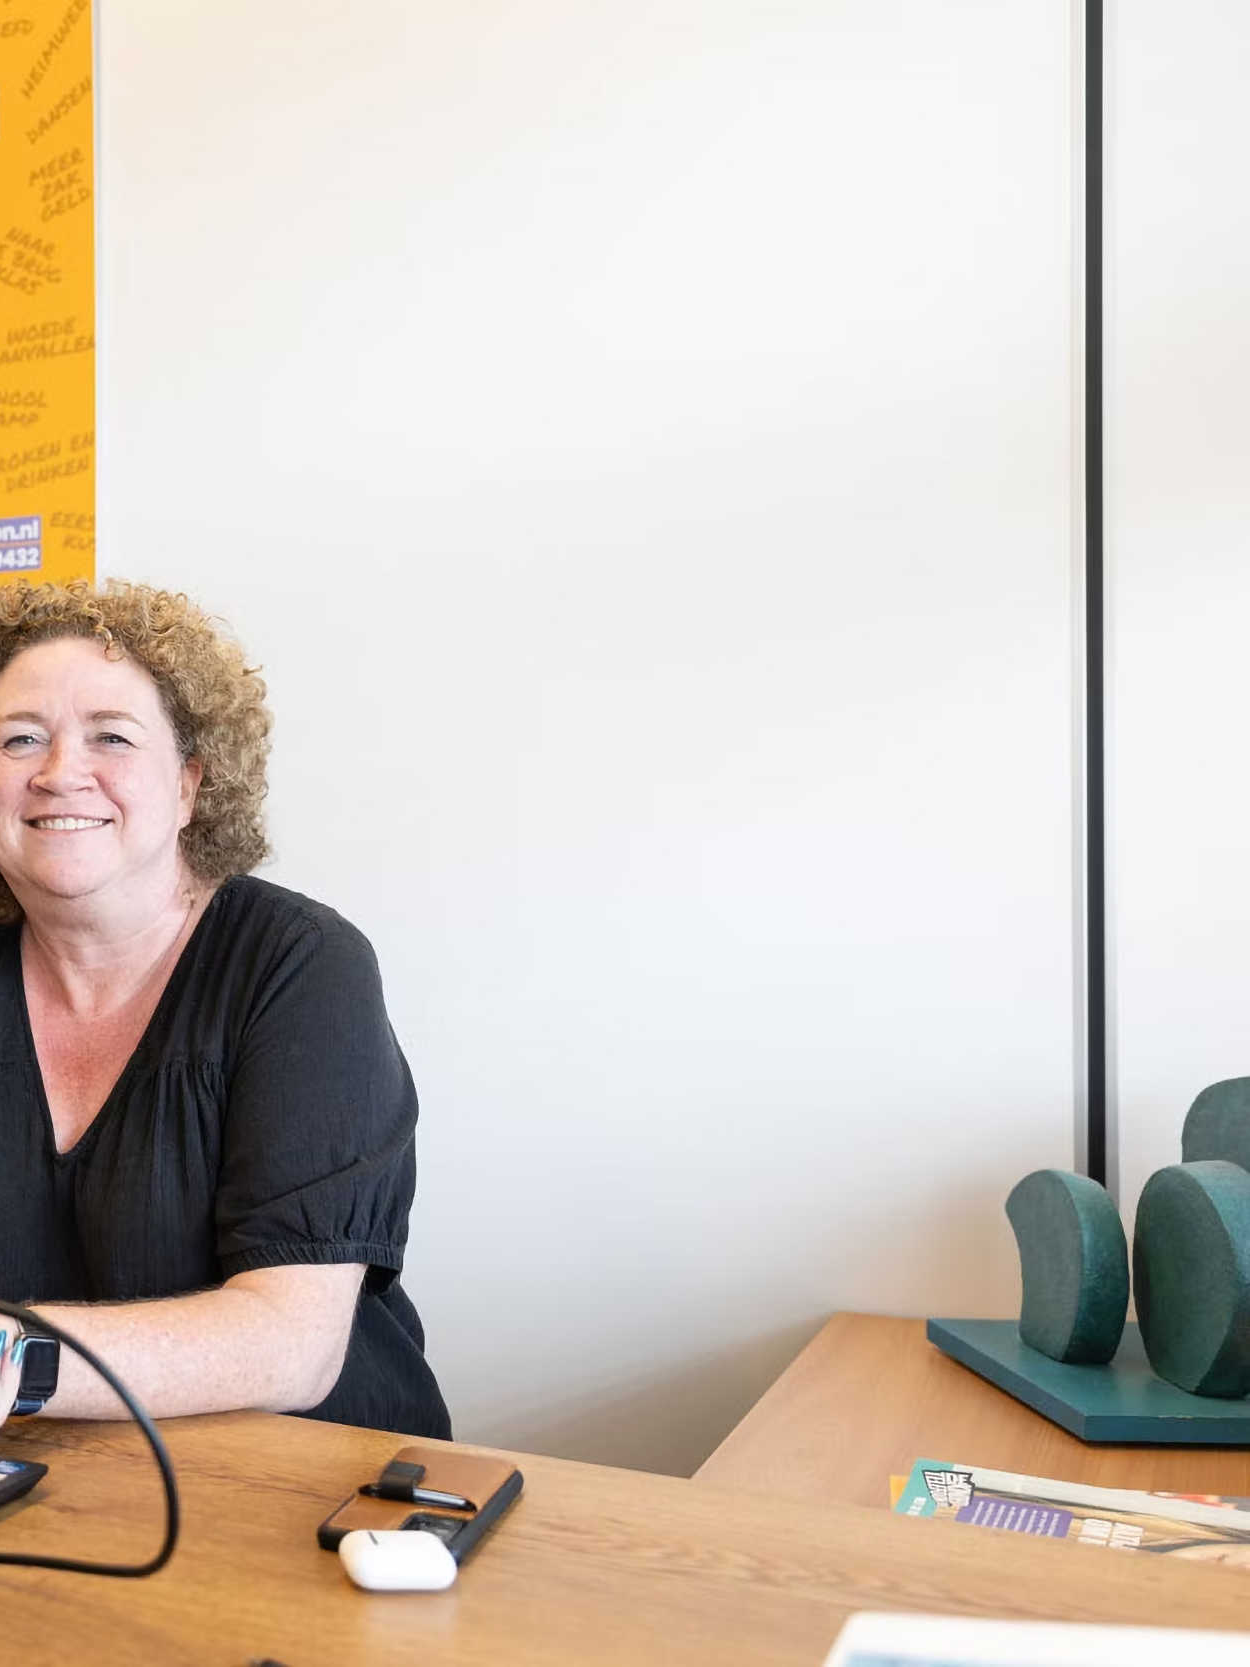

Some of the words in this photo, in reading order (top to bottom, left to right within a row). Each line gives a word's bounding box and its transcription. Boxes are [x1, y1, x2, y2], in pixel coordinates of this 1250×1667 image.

[28, 147, 86, 188] MEER
[40, 187, 91, 224] GELD
[5, 315, 77, 347] WOEDE
[6, 454, 89, 494] DRINKEN
